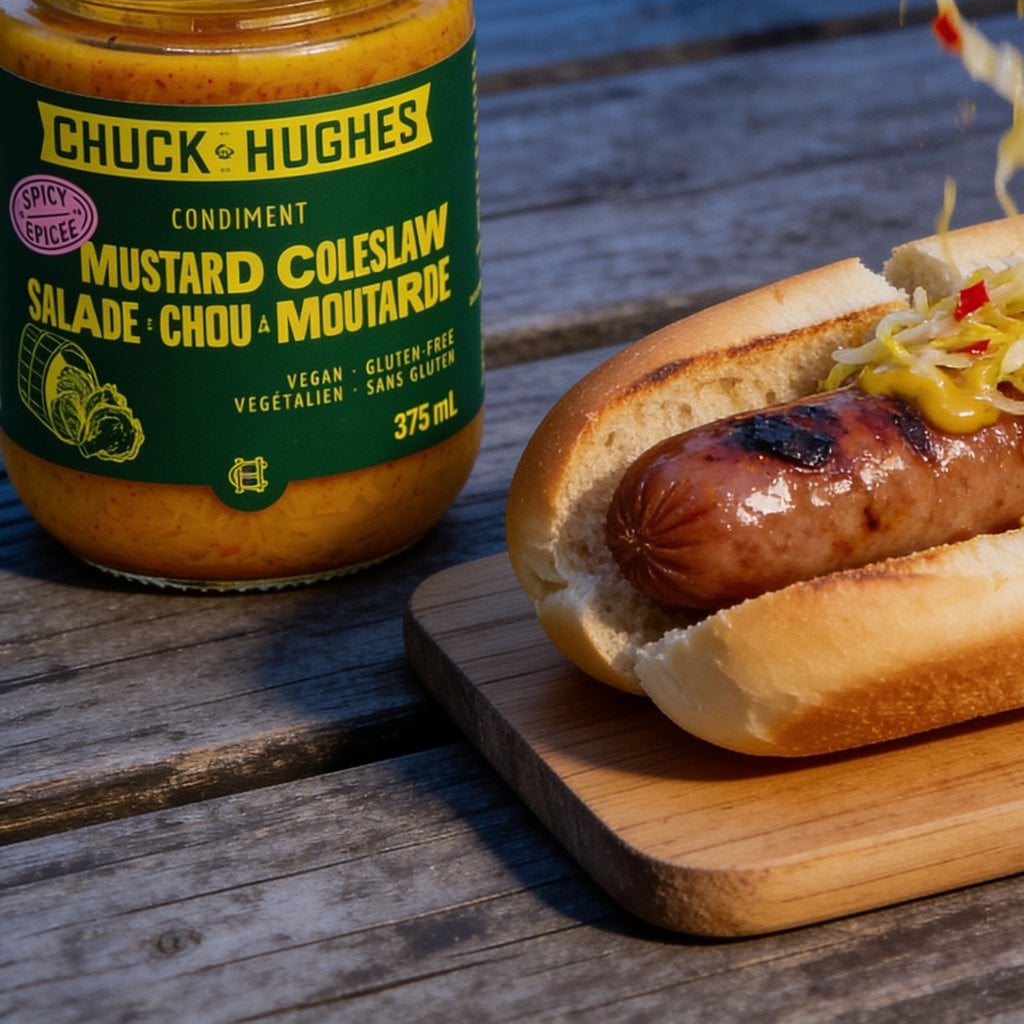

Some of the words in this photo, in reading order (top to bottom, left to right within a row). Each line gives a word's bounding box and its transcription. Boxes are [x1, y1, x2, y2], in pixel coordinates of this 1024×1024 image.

[53, 115, 211, 174] CHUCK
[246, 99, 418, 173] HUGHES
[22, 185, 67, 210] SPICY
[172, 201, 308, 230] CONDIMENT
[80, 240, 265, 295] MUSTARD
[276, 201, 449, 290] COLESLAW
[27, 277, 141, 344] SALADE
[159, 303, 252, 348] CHOU
[276, 255, 451, 344] MOUTARDE
[287, 366, 343, 390] VEGAN
[366, 371, 404, 396] SANS
[409, 349, 455, 383] GLUTEN
[394, 402, 430, 440] 375
[433, 389, 458, 426] mL
